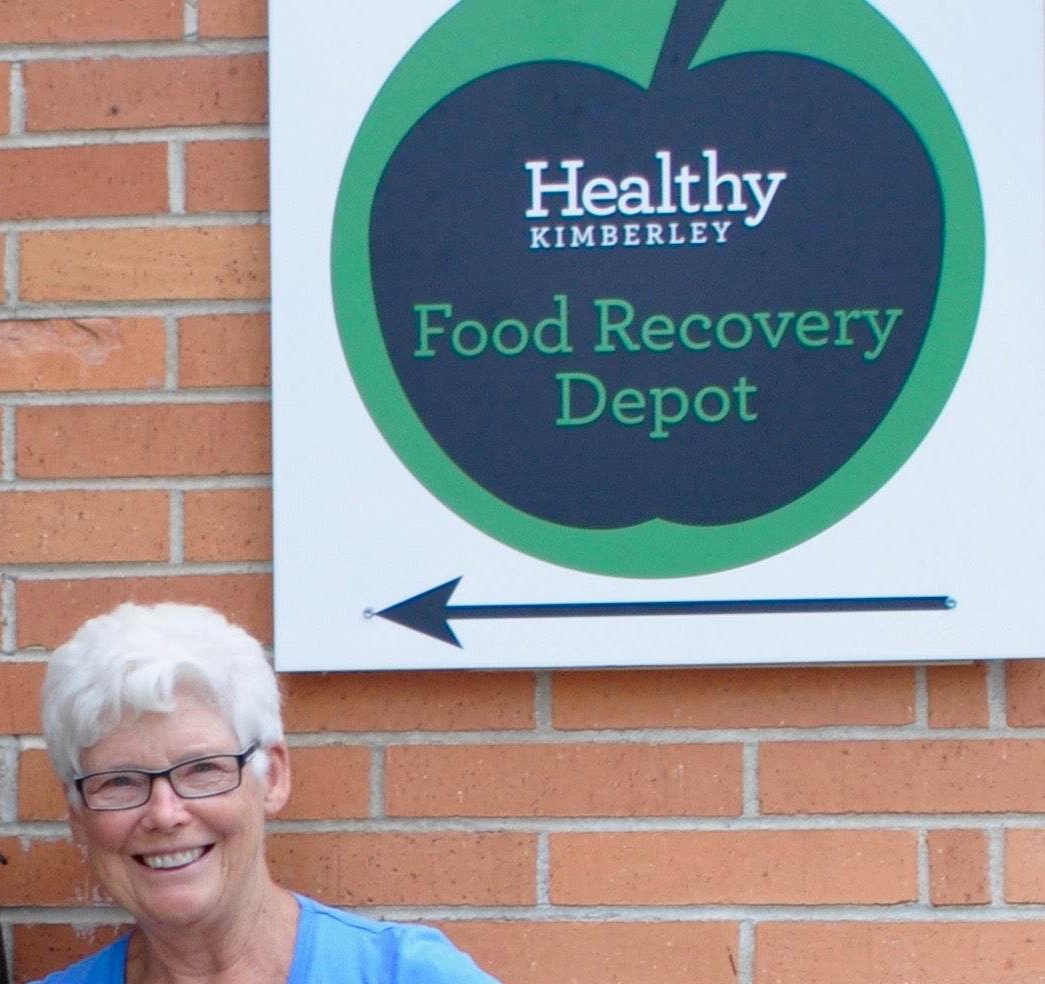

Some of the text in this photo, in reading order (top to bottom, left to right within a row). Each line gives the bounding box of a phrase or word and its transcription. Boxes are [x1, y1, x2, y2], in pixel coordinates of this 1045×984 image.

[524, 149, 787, 226] Healthy
[529, 220, 732, 249] KIMBERLEY
[413, 294, 904, 360] Food Recovery
[555, 371, 758, 438] Depot
